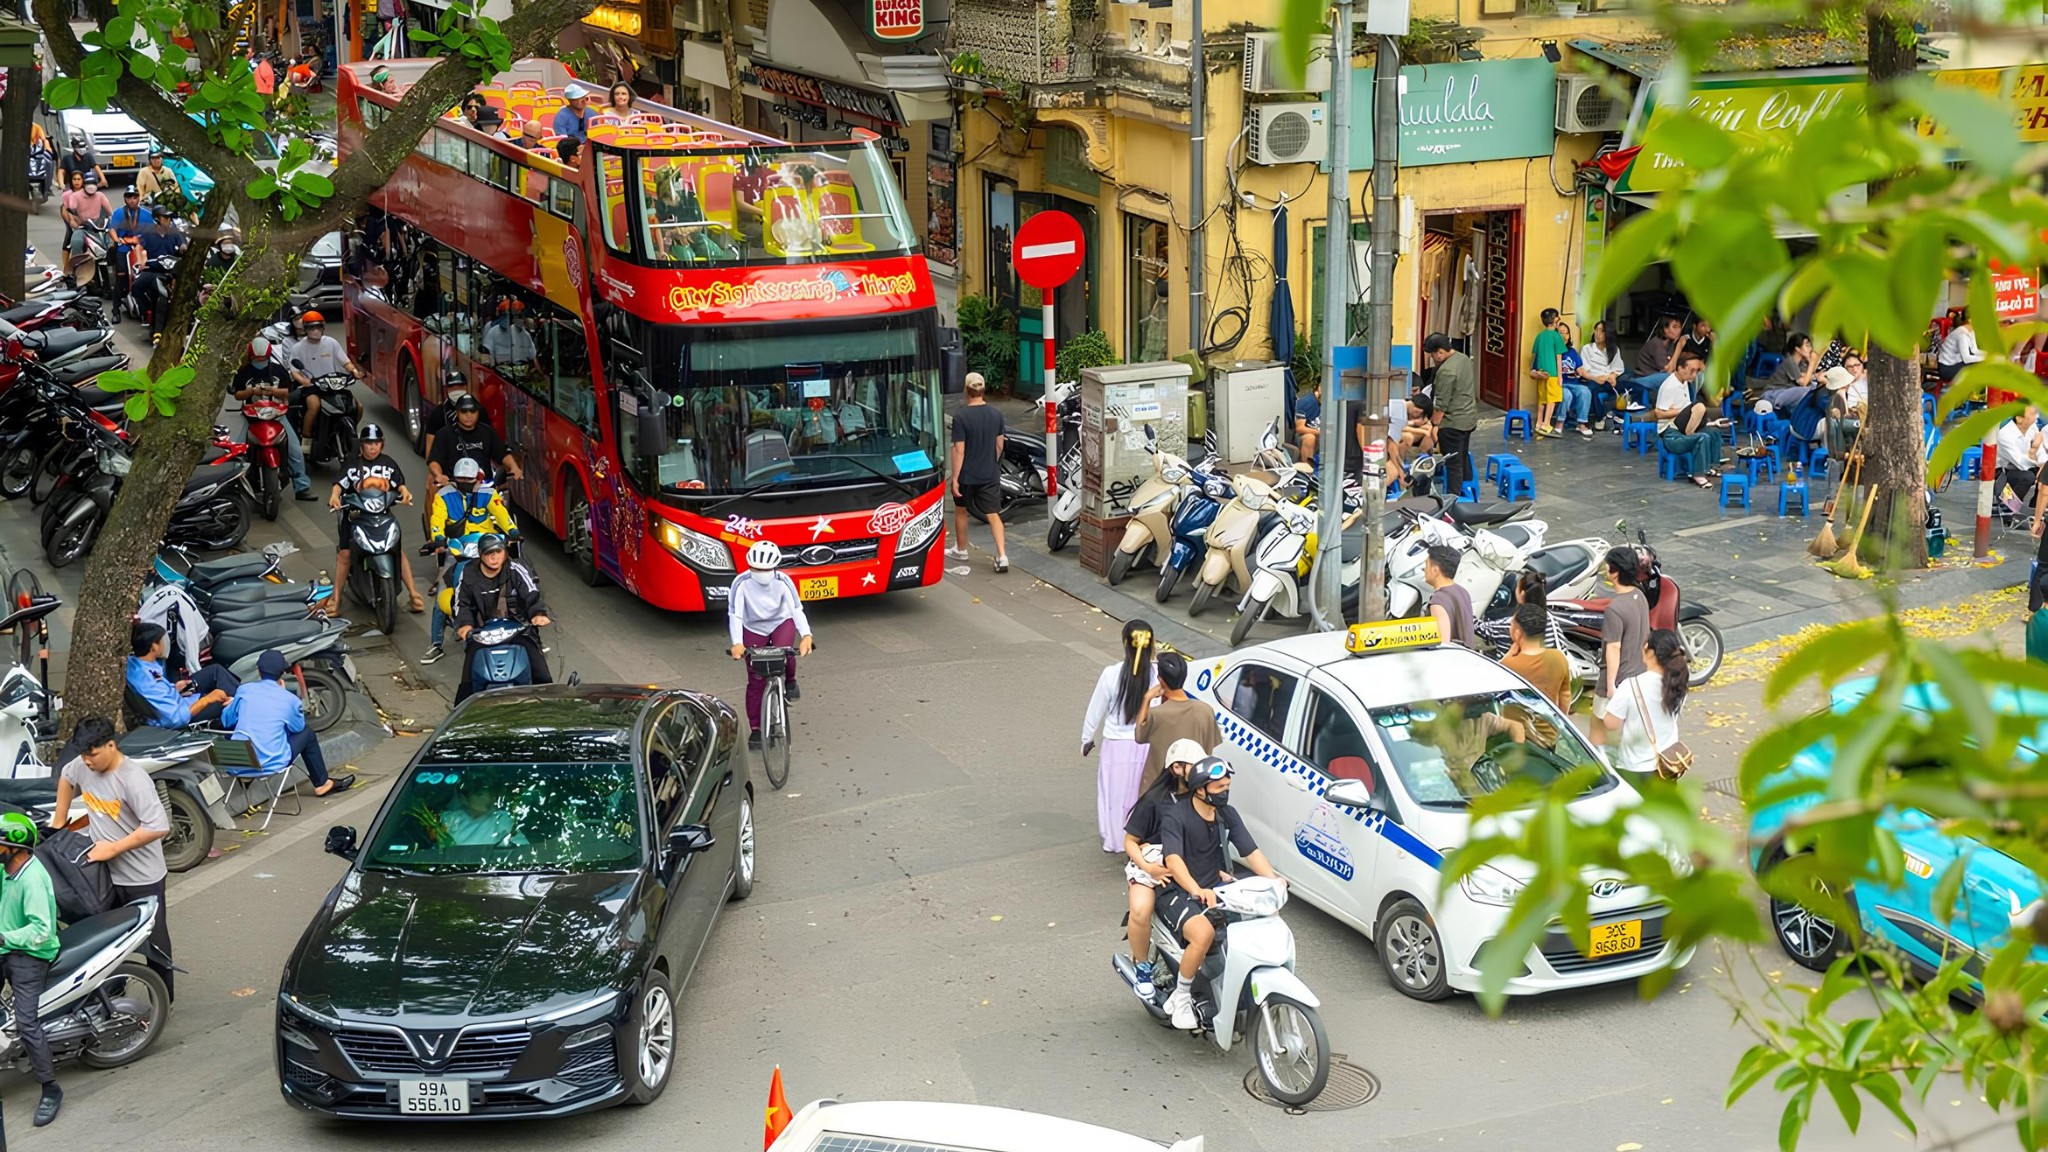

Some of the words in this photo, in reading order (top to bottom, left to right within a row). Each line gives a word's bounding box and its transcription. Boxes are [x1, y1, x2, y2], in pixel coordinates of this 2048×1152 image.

[876, 9, 921, 27] KING
[862, 271, 917, 297] Hanoi
[418, 1082, 448, 1096] 99A
[408, 1097, 461, 1111] 556.10
